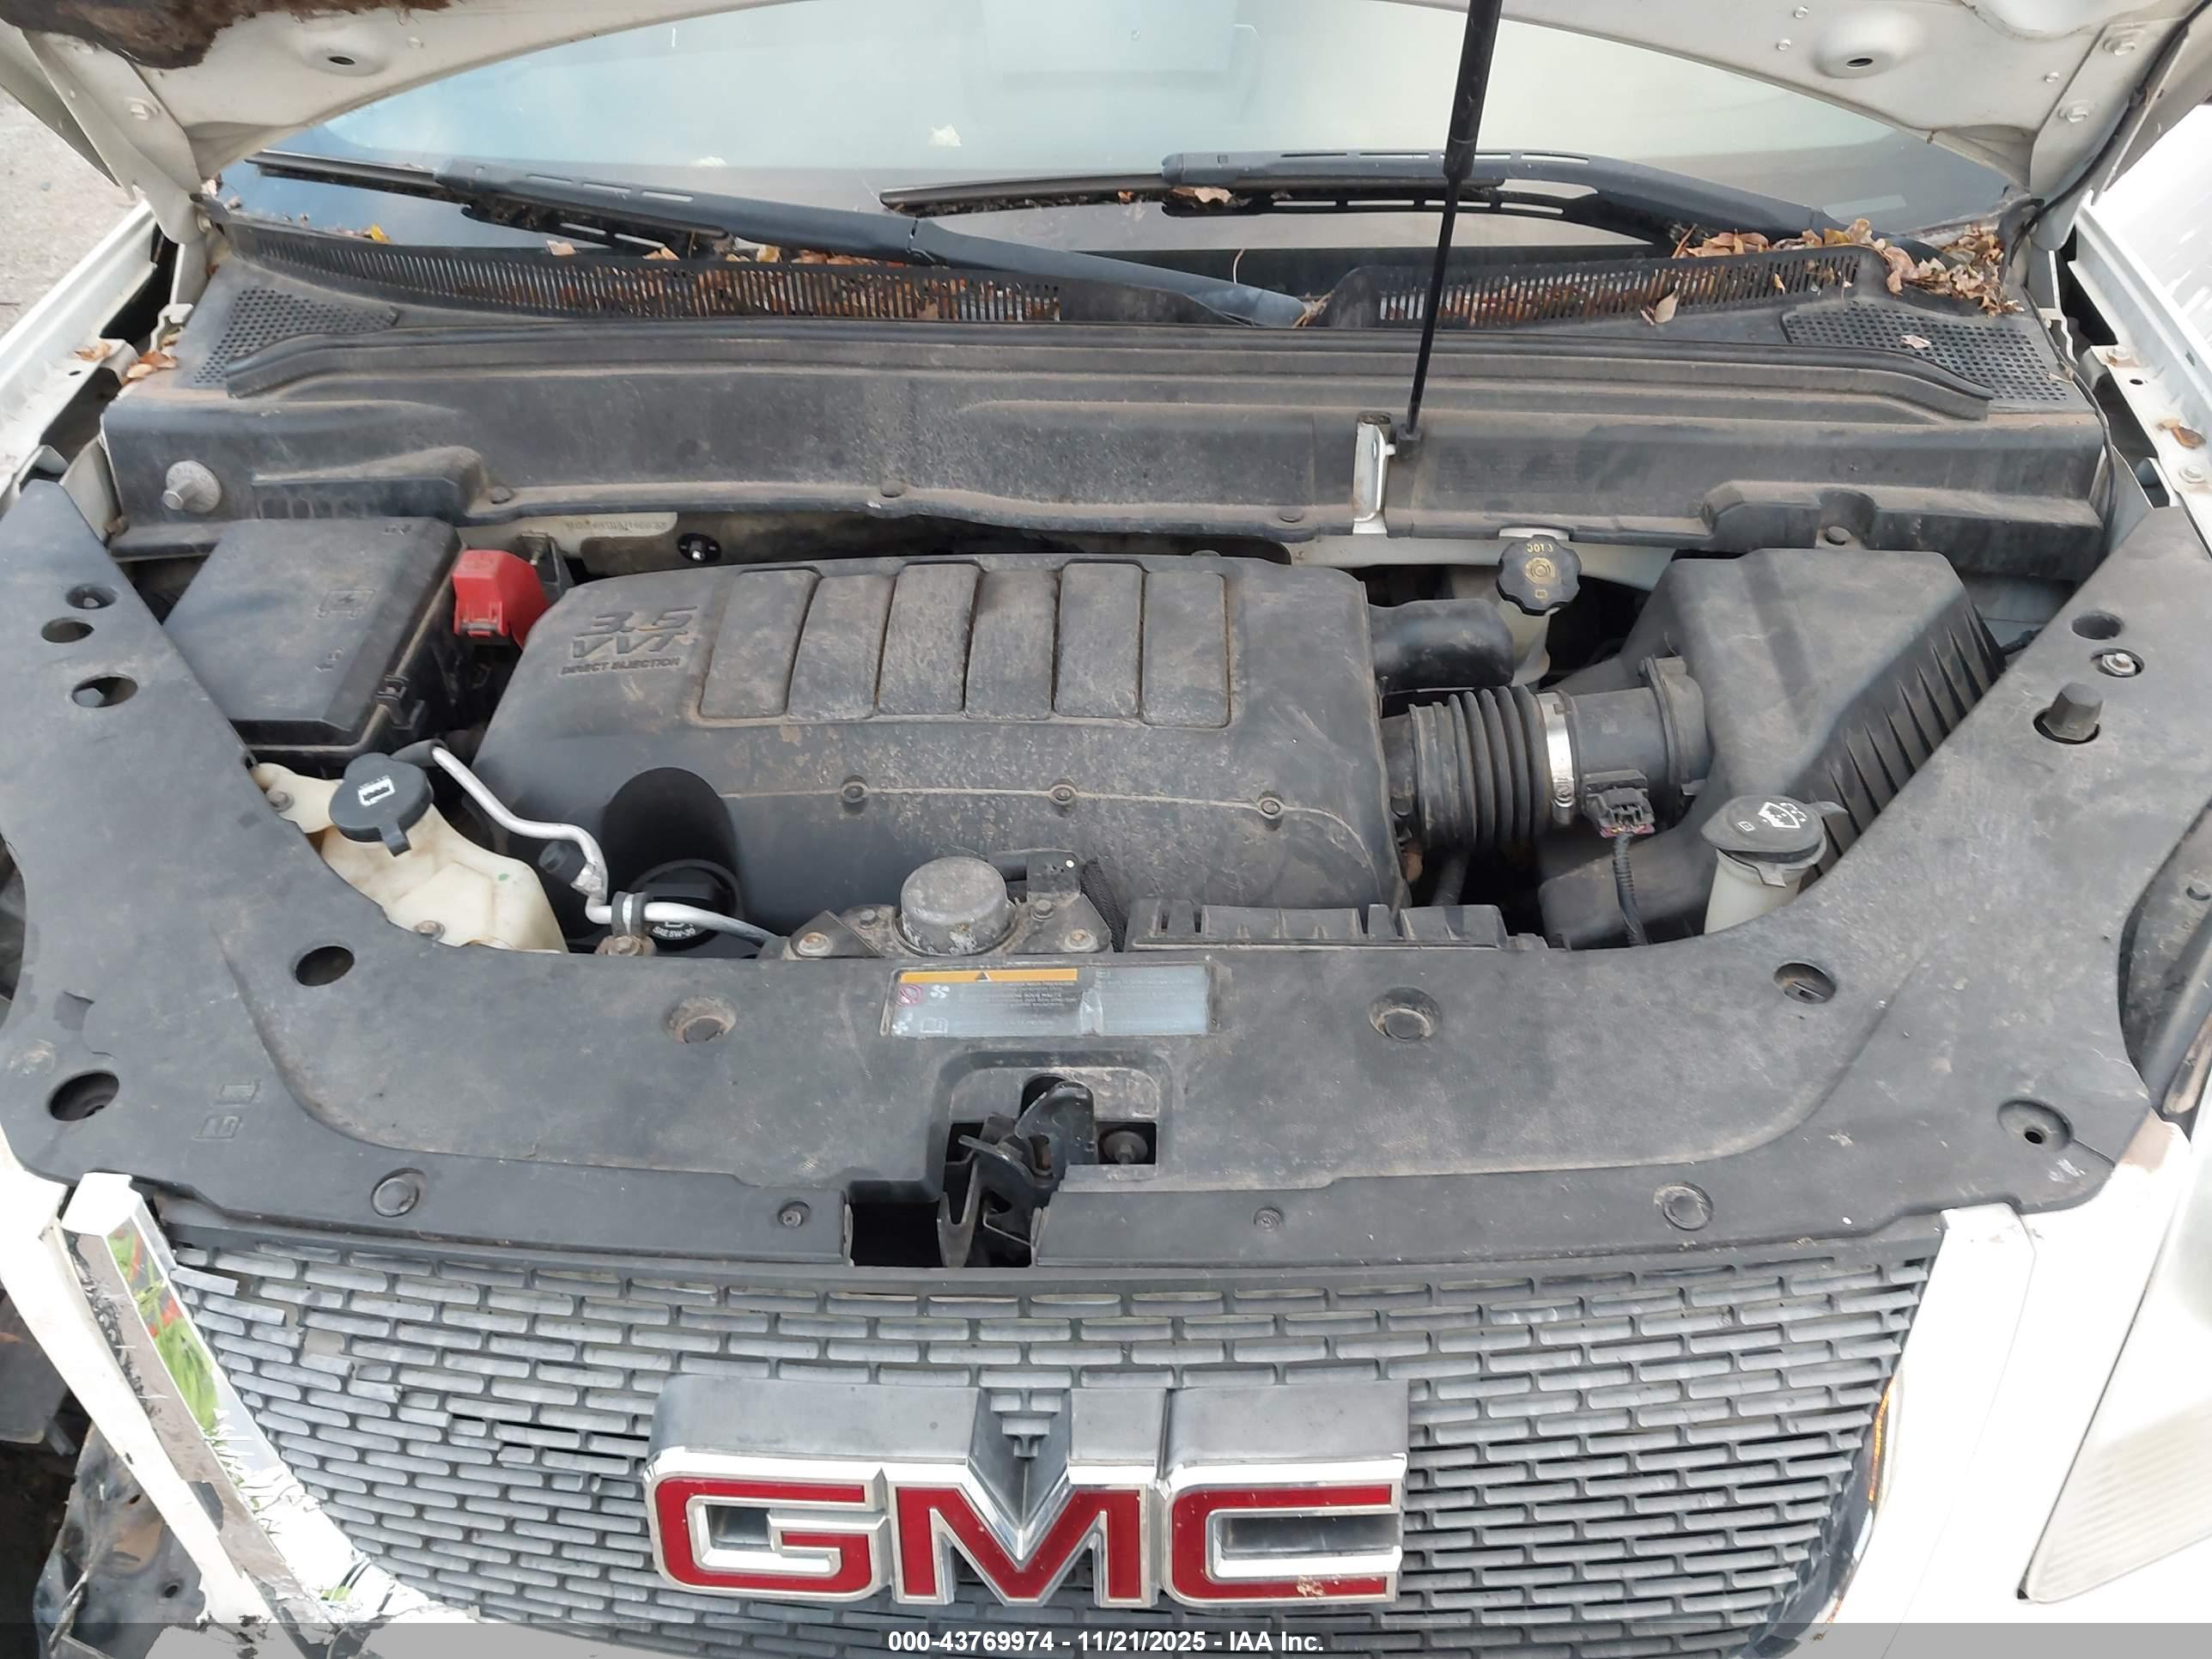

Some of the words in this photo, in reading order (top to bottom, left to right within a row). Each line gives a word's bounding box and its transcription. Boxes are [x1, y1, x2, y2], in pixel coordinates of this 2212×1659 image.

[573, 629, 690, 659] VVT
[561, 660, 610, 675] DIRECT
[611, 657, 681, 671] INJECTION
[646, 1453, 1406, 1608] GMC
